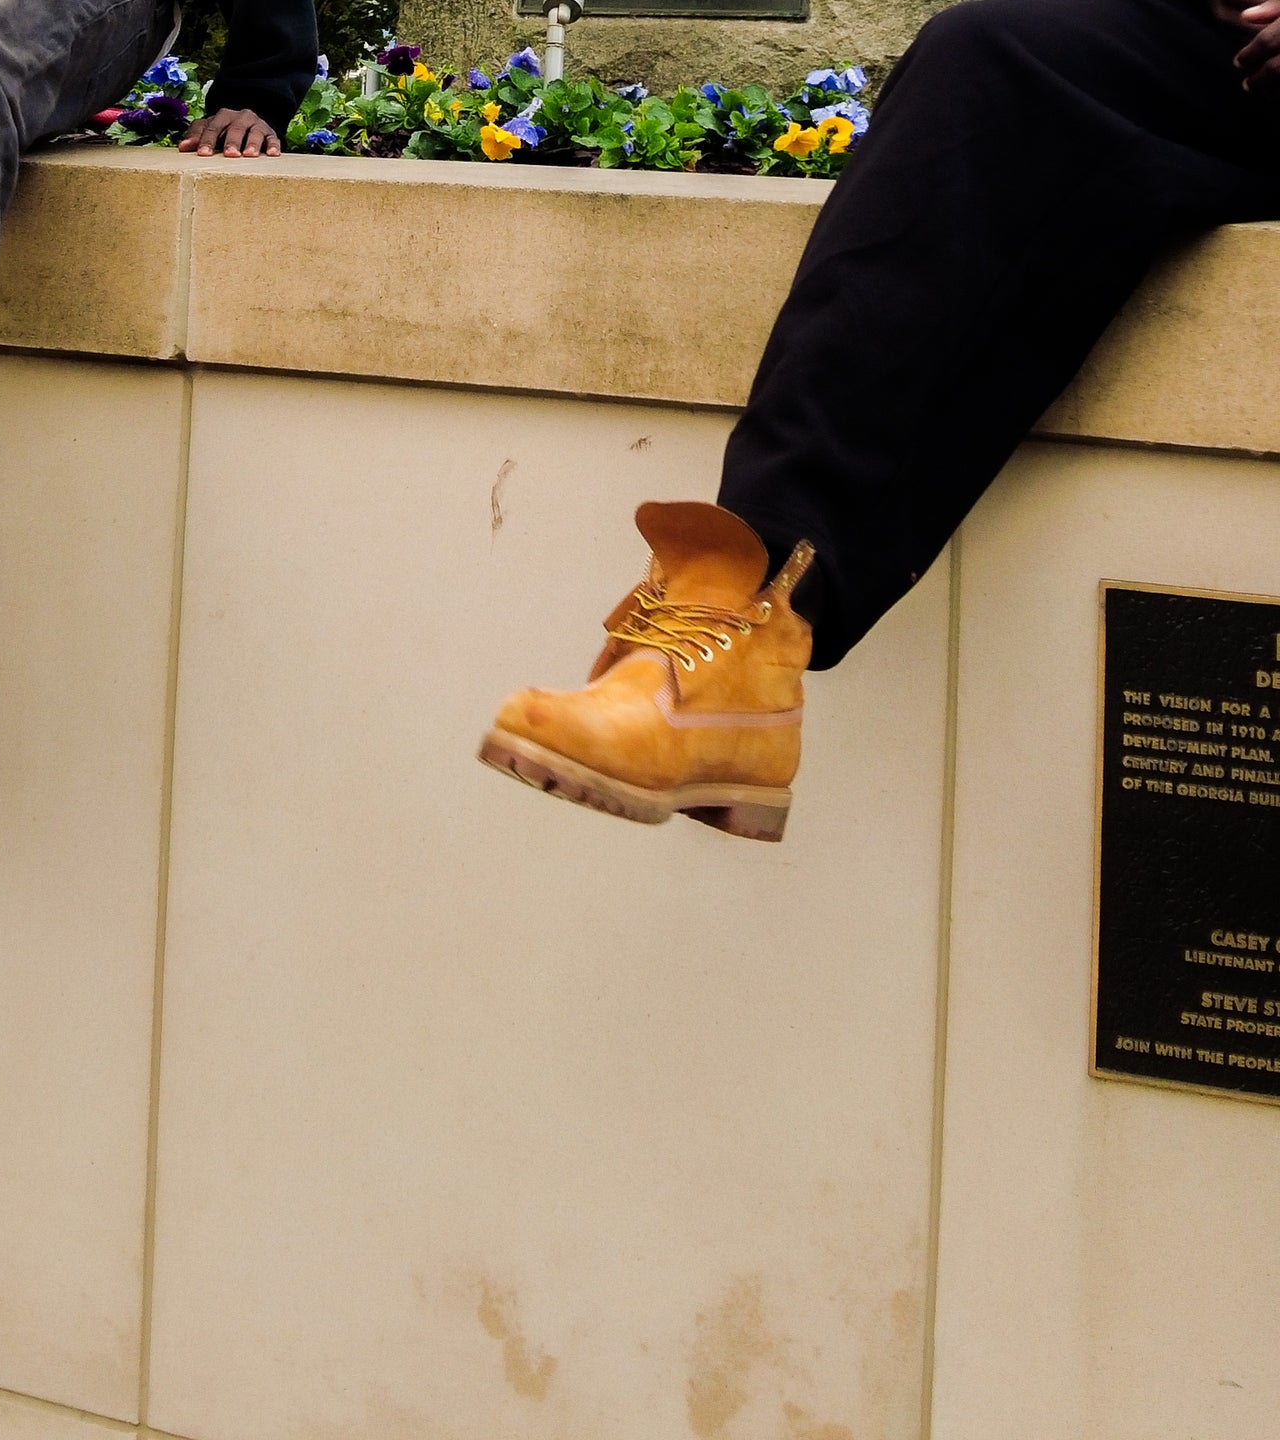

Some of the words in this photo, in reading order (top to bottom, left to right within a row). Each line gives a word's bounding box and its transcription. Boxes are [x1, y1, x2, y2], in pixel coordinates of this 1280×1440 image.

[1122, 689, 1150, 706] THE
[1159, 693, 1211, 713] VISION
[1222, 700, 1250, 717] FOR
[1260, 704, 1270, 719] A
[1122, 712, 1200, 734] PROPOSED
[1206, 720, 1223, 736] IN
[1231, 723, 1265, 741] 1910
[1122, 734, 1227, 758] DEVELOPMENT
[1232, 745, 1274, 763] PLAN.
[1121, 755, 1187, 775] CENTURY
[1192, 763, 1224, 779] AND
[1121, 777, 1142, 792] OF
[1146, 779, 1173, 795] THE
[1177, 783, 1244, 803] GEORGIA
[1209, 929, 1269, 952] CASEY
[1184, 949, 1274, 973] LIEUTENANT
[1200, 990, 1257, 1014] STEVE
[1179, 1011, 1222, 1029] STATE
[1114, 1035, 1150, 1054] JOIN
[1155, 1041, 1192, 1060] WITH
[1196, 1047, 1224, 1064] THE
[1229, 1052, 1280, 1073] PEOPLE
